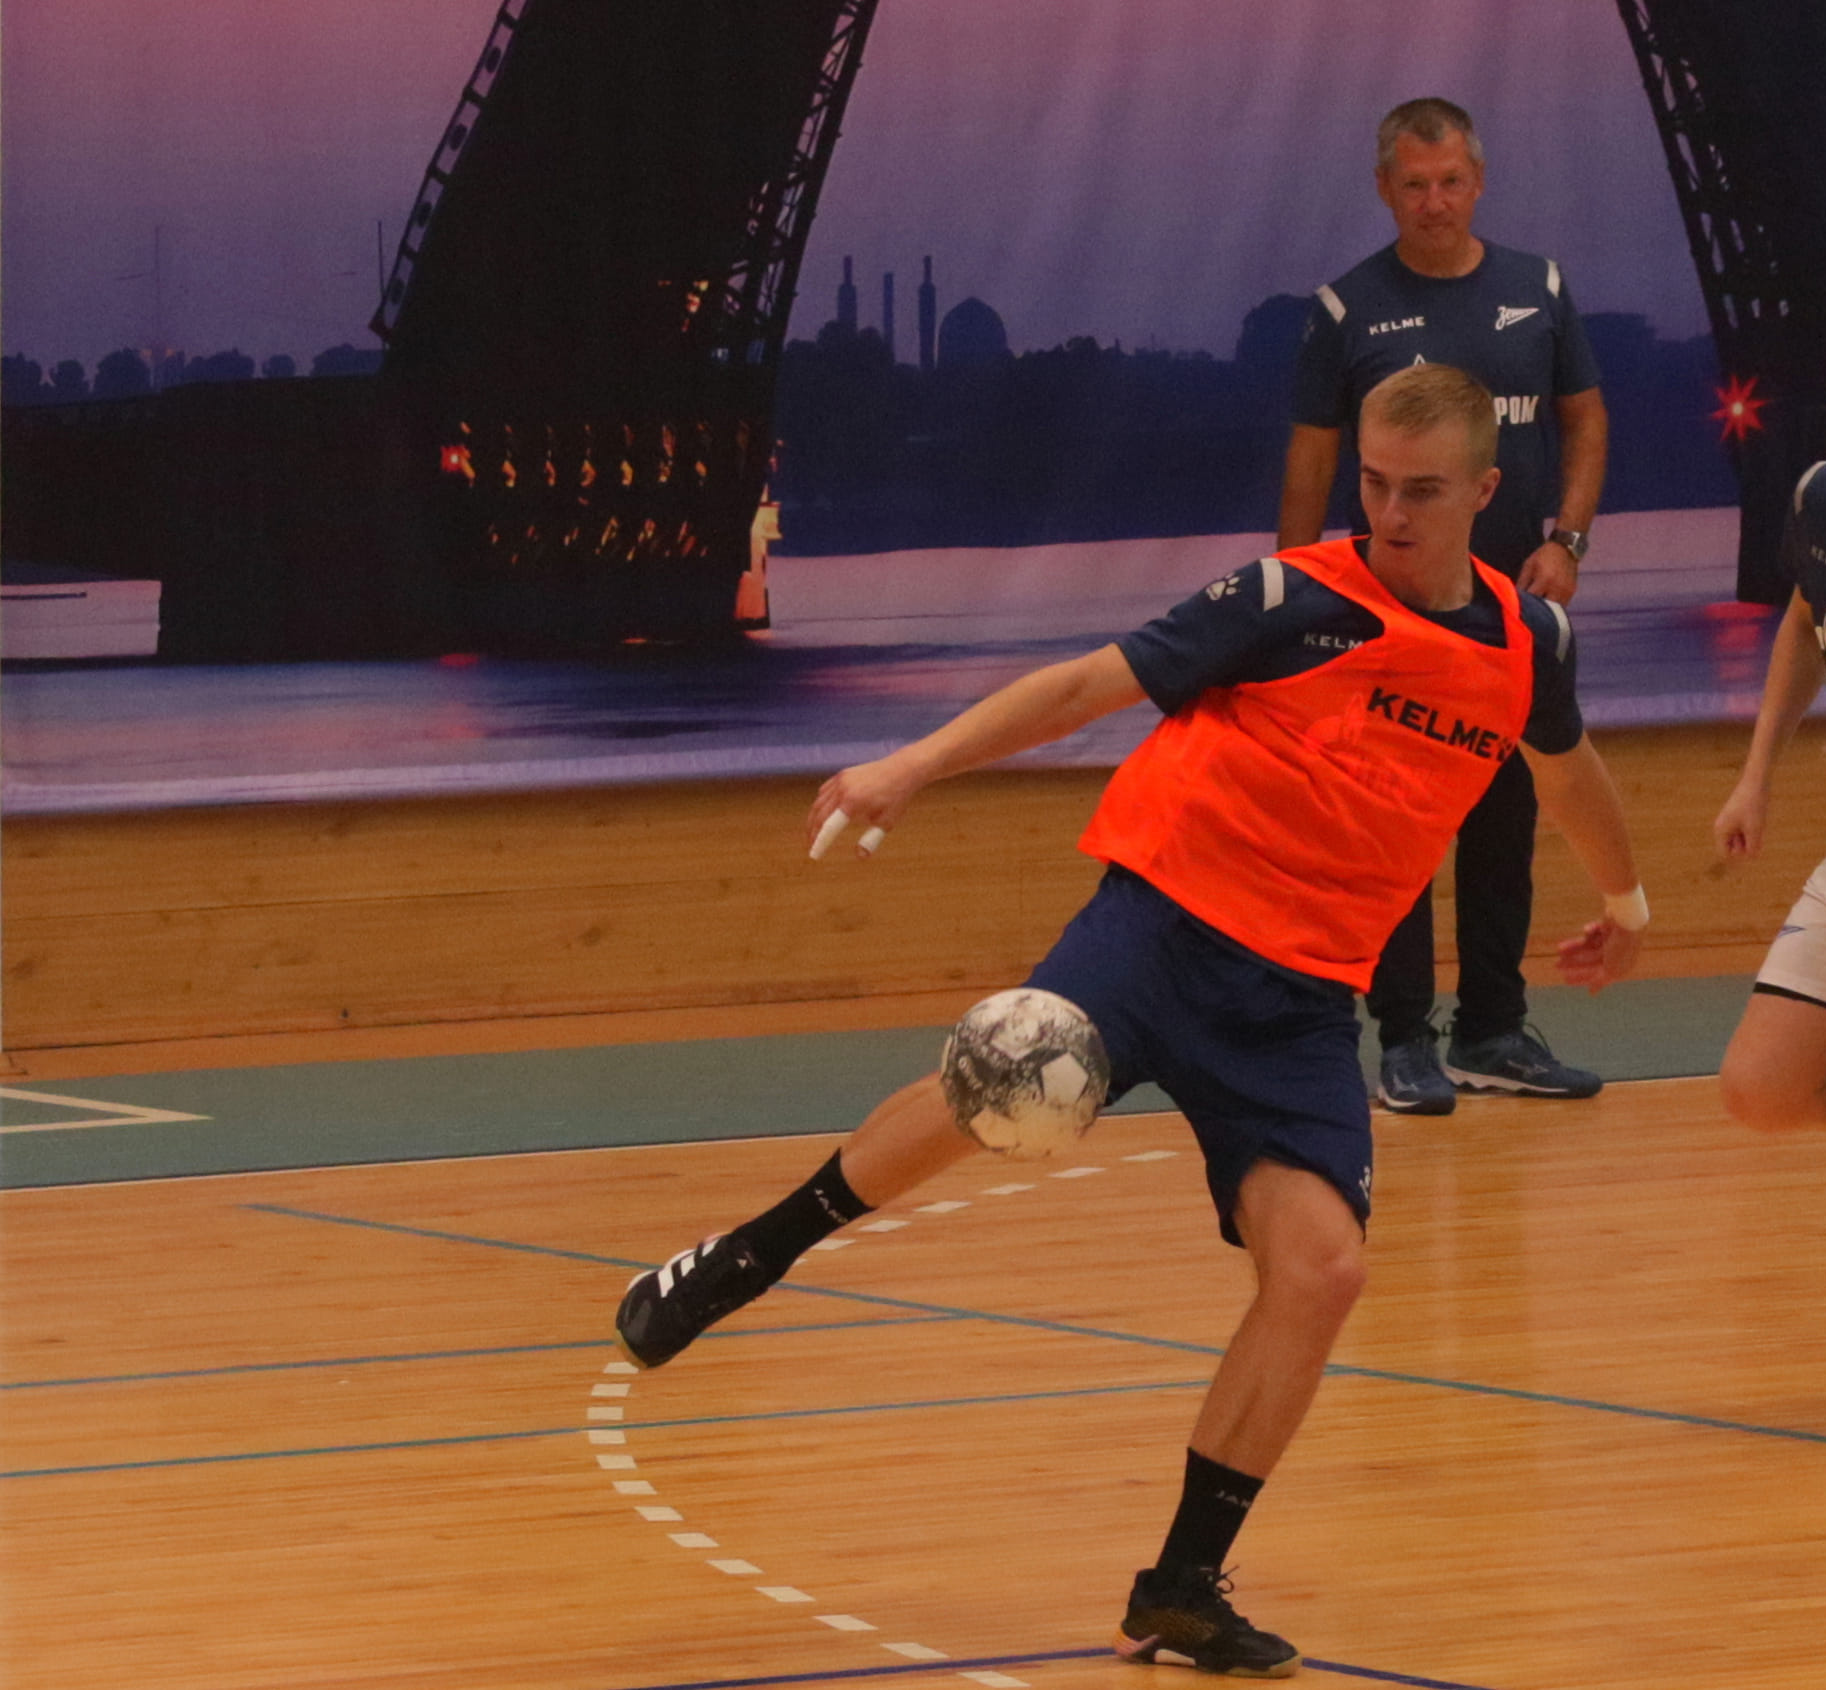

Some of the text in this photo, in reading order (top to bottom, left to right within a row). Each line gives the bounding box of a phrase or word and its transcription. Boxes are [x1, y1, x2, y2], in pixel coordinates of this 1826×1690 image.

[1369, 316, 1426, 335] KELME
[1303, 632, 1364, 650] KELM
[1367, 687, 1500, 759] KELME
